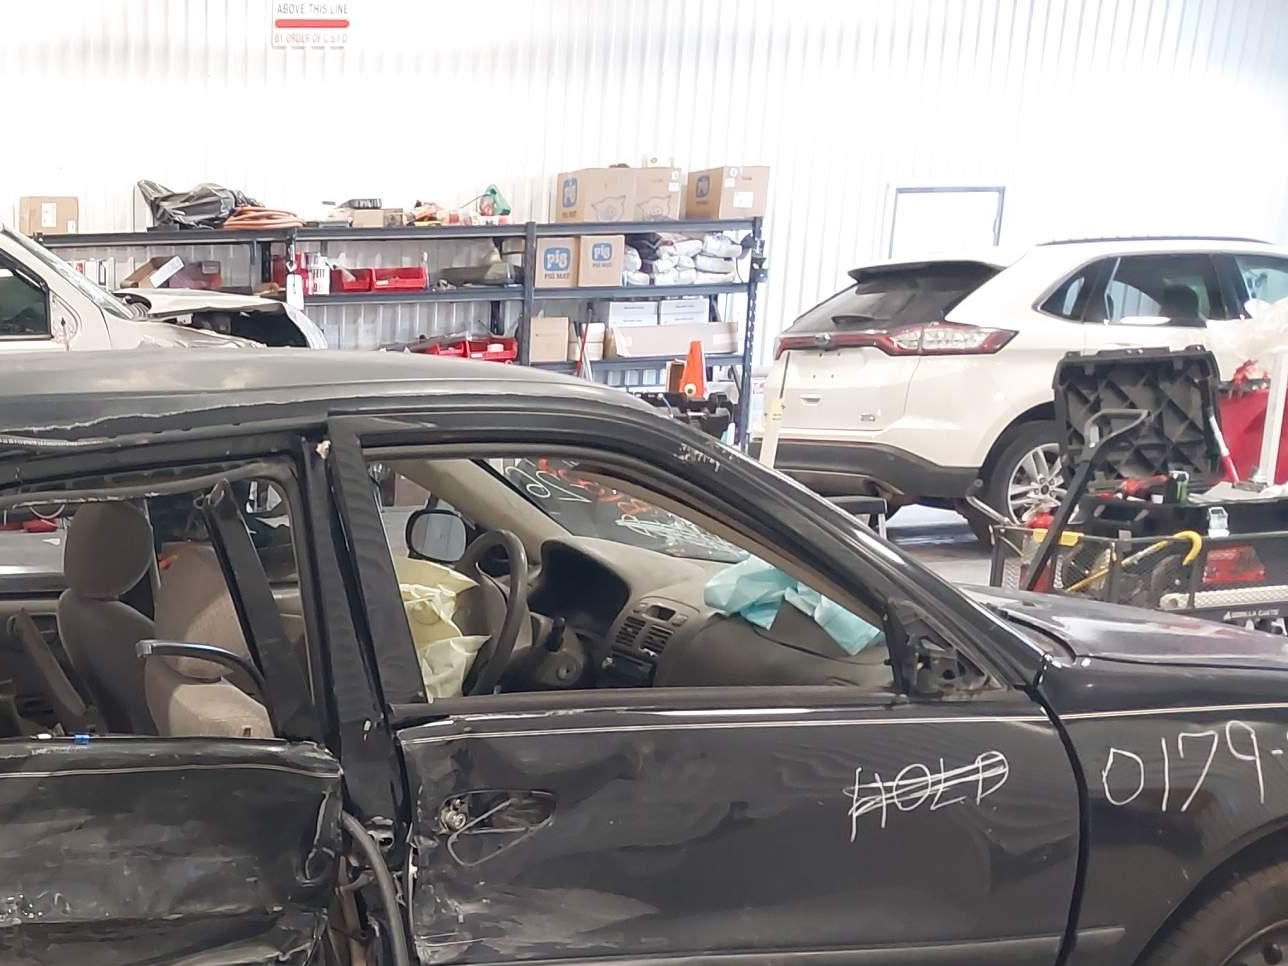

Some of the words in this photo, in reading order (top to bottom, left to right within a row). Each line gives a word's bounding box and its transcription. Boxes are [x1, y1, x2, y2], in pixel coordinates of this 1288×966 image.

[277, 3, 305, 14] ABOVE
[309, 3, 327, 14] THIS
[330, 3, 348, 14] LINE
[546, 249, 569, 269] pig
